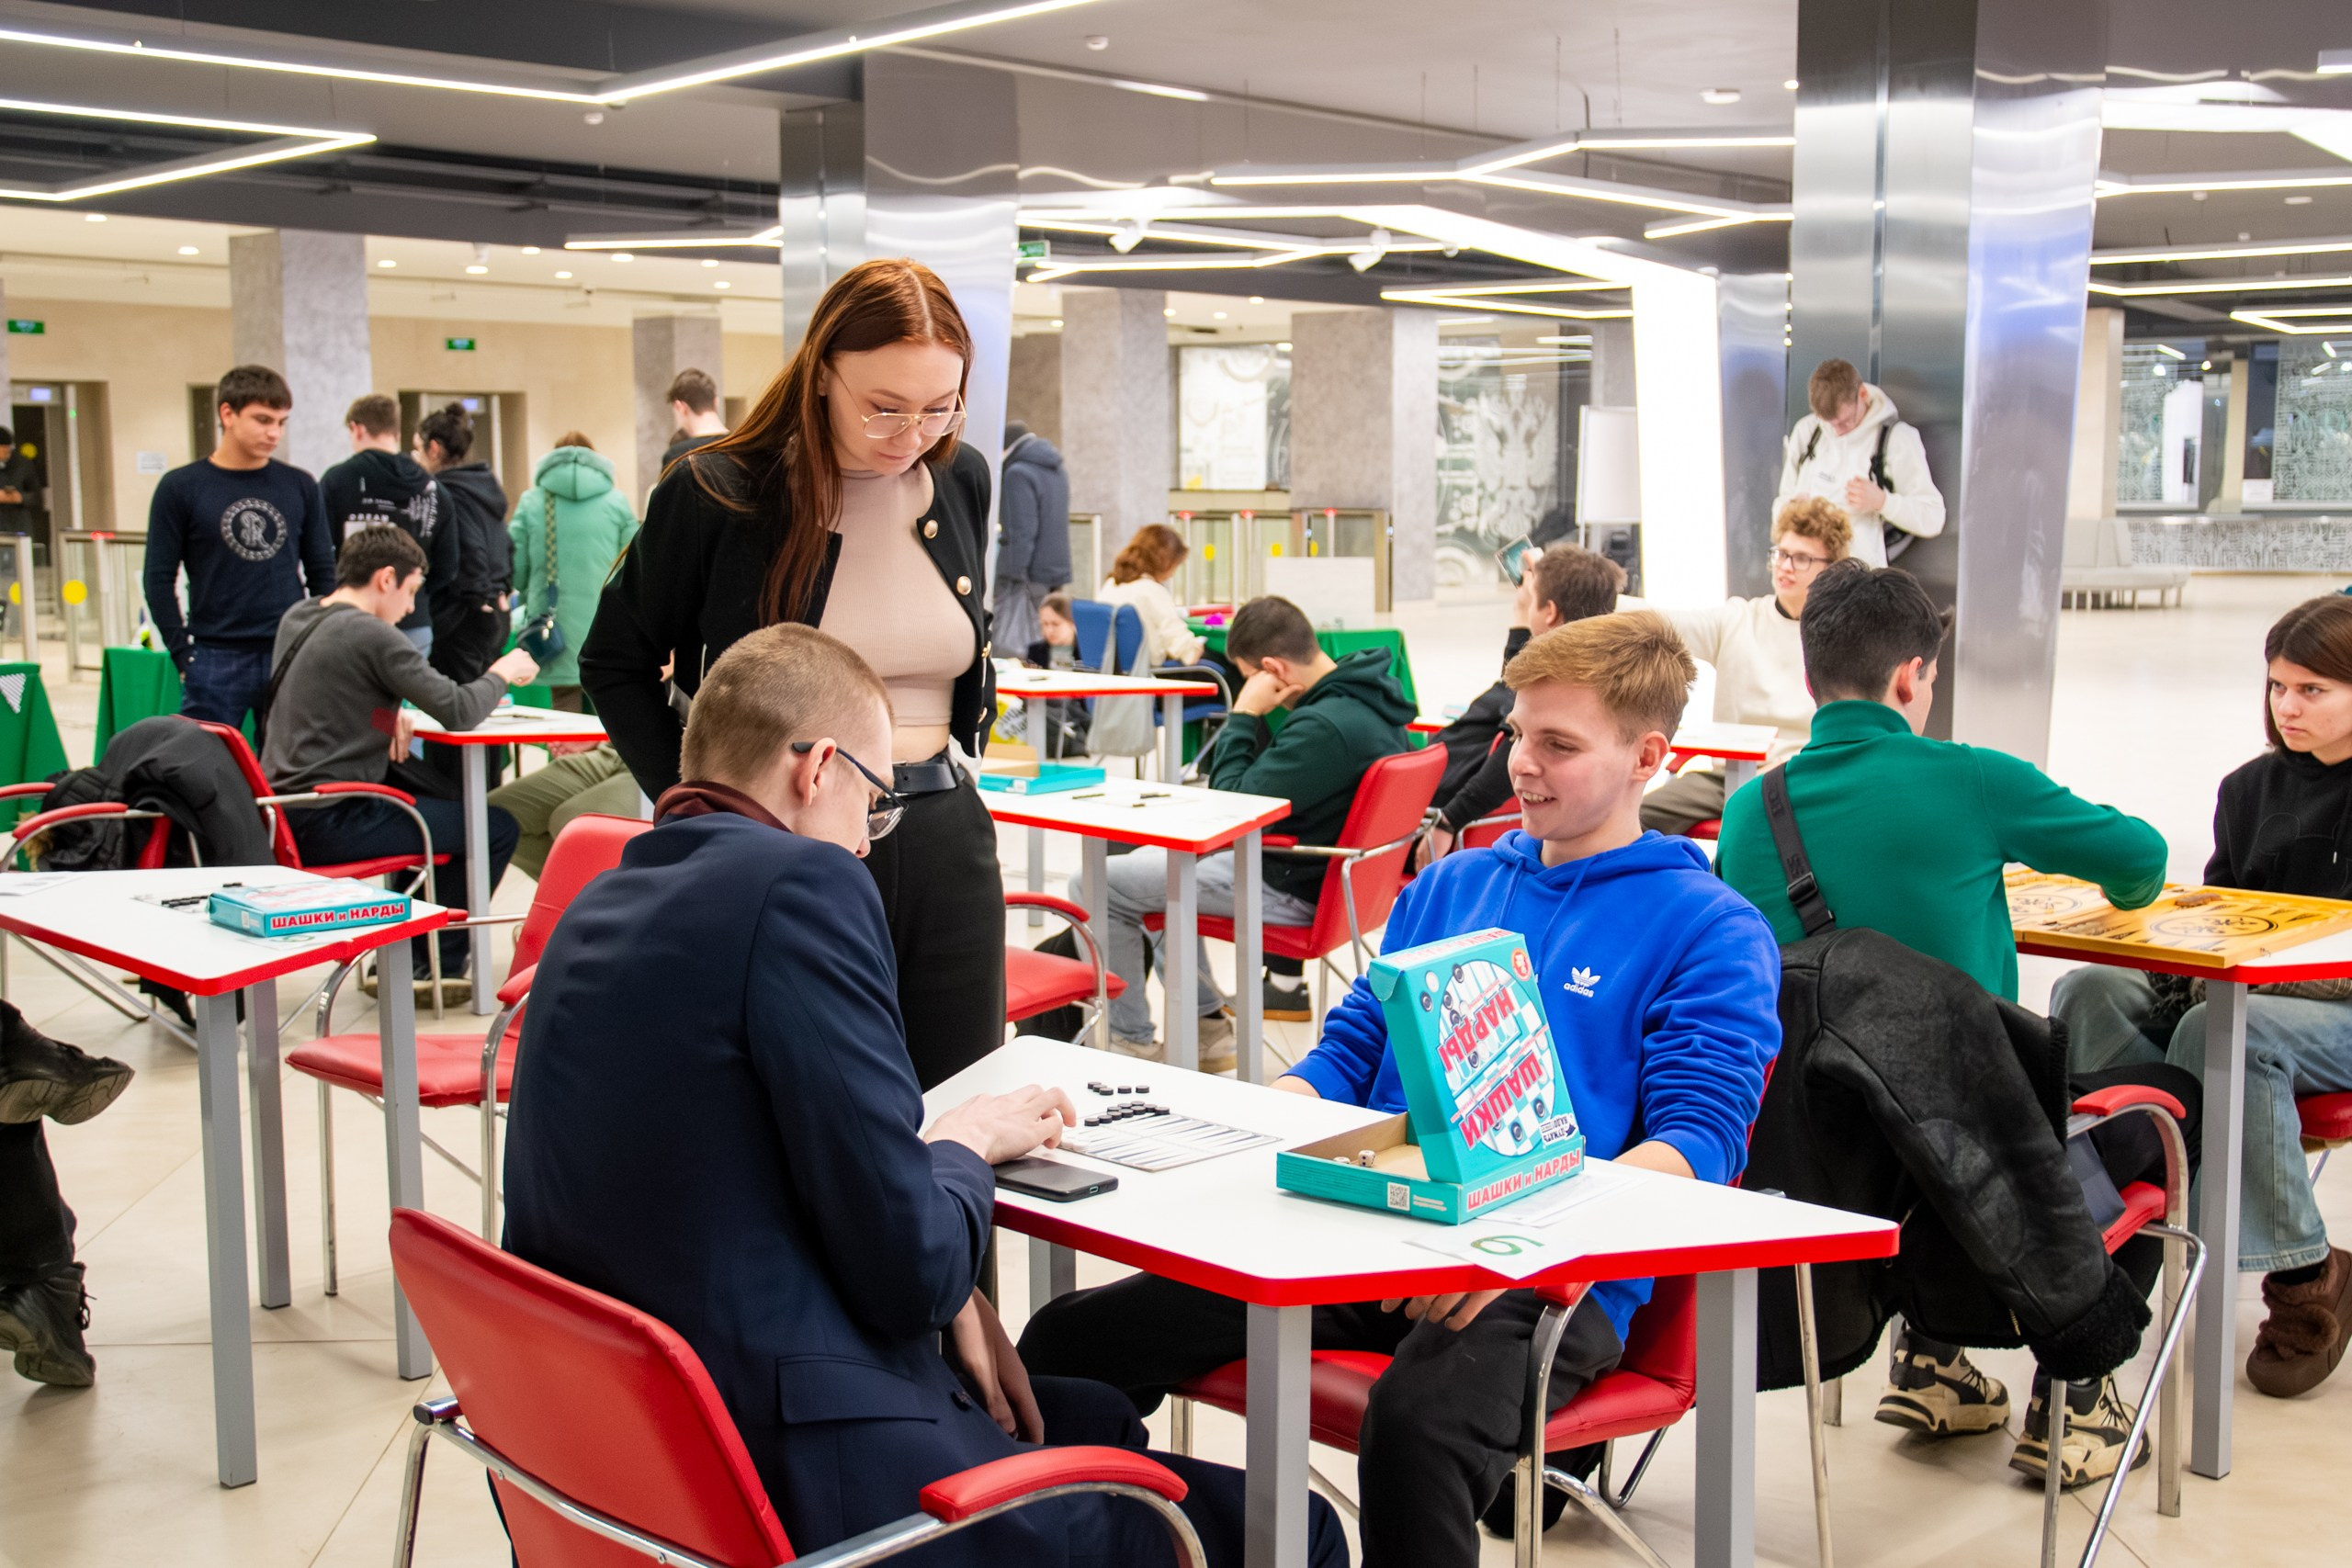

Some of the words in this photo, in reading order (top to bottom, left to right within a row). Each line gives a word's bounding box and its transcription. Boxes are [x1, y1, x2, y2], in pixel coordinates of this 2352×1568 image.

[272, 911, 334, 929] ШАШКИ
[350, 903, 404, 919] НАРДЫ
[1564, 982, 1595, 998] adidas
[1438, 987, 1515, 1073] НАРДЫ
[1459, 1051, 1544, 1148] ШАШКИ
[1467, 1173, 1522, 1211] ШАШКИ
[1534, 1149, 1580, 1181] НАРДЫ
